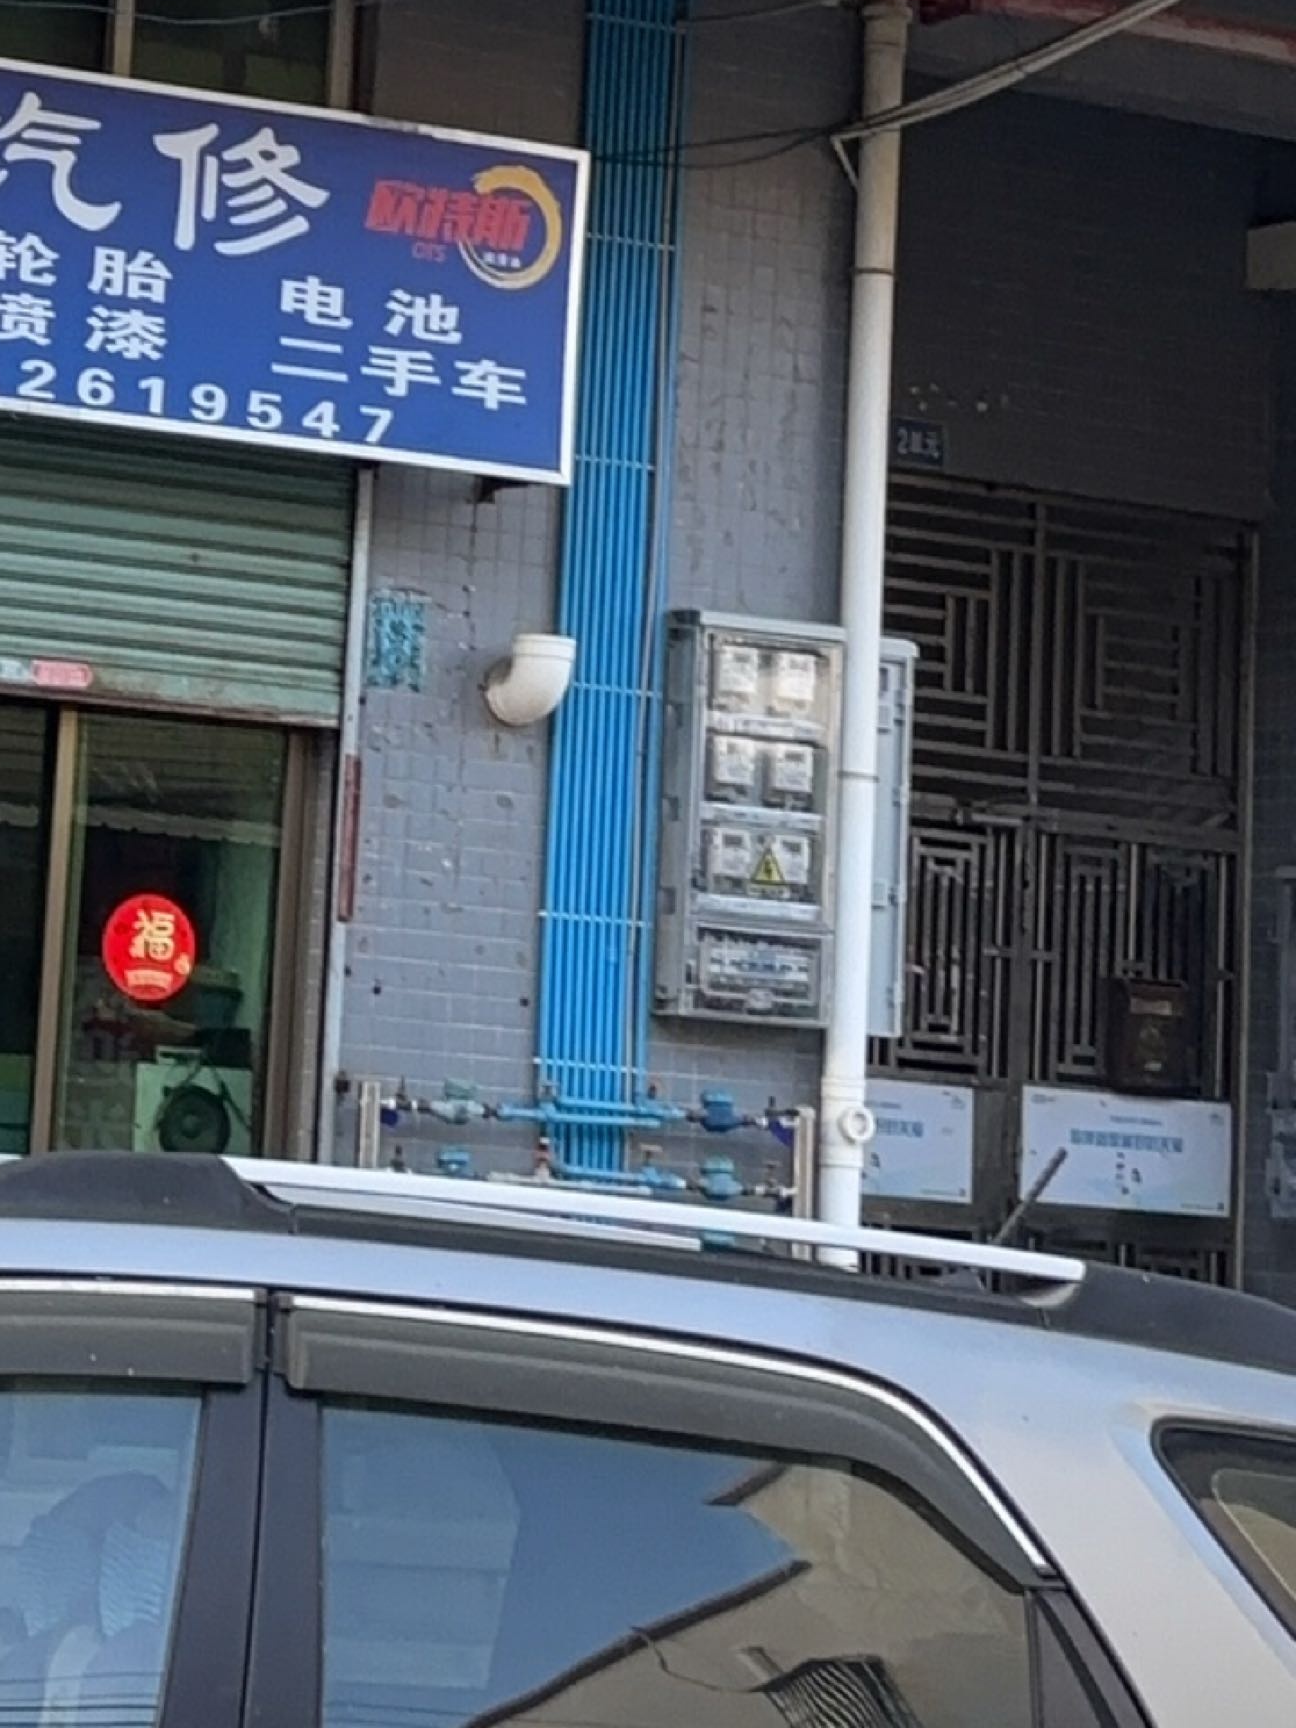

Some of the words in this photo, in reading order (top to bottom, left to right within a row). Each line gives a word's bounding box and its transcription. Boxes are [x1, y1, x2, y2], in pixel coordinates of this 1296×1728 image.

[280, 275, 464, 345] 电池
[271, 335, 528, 410] 二手车
[129, 908, 175, 961] 福
